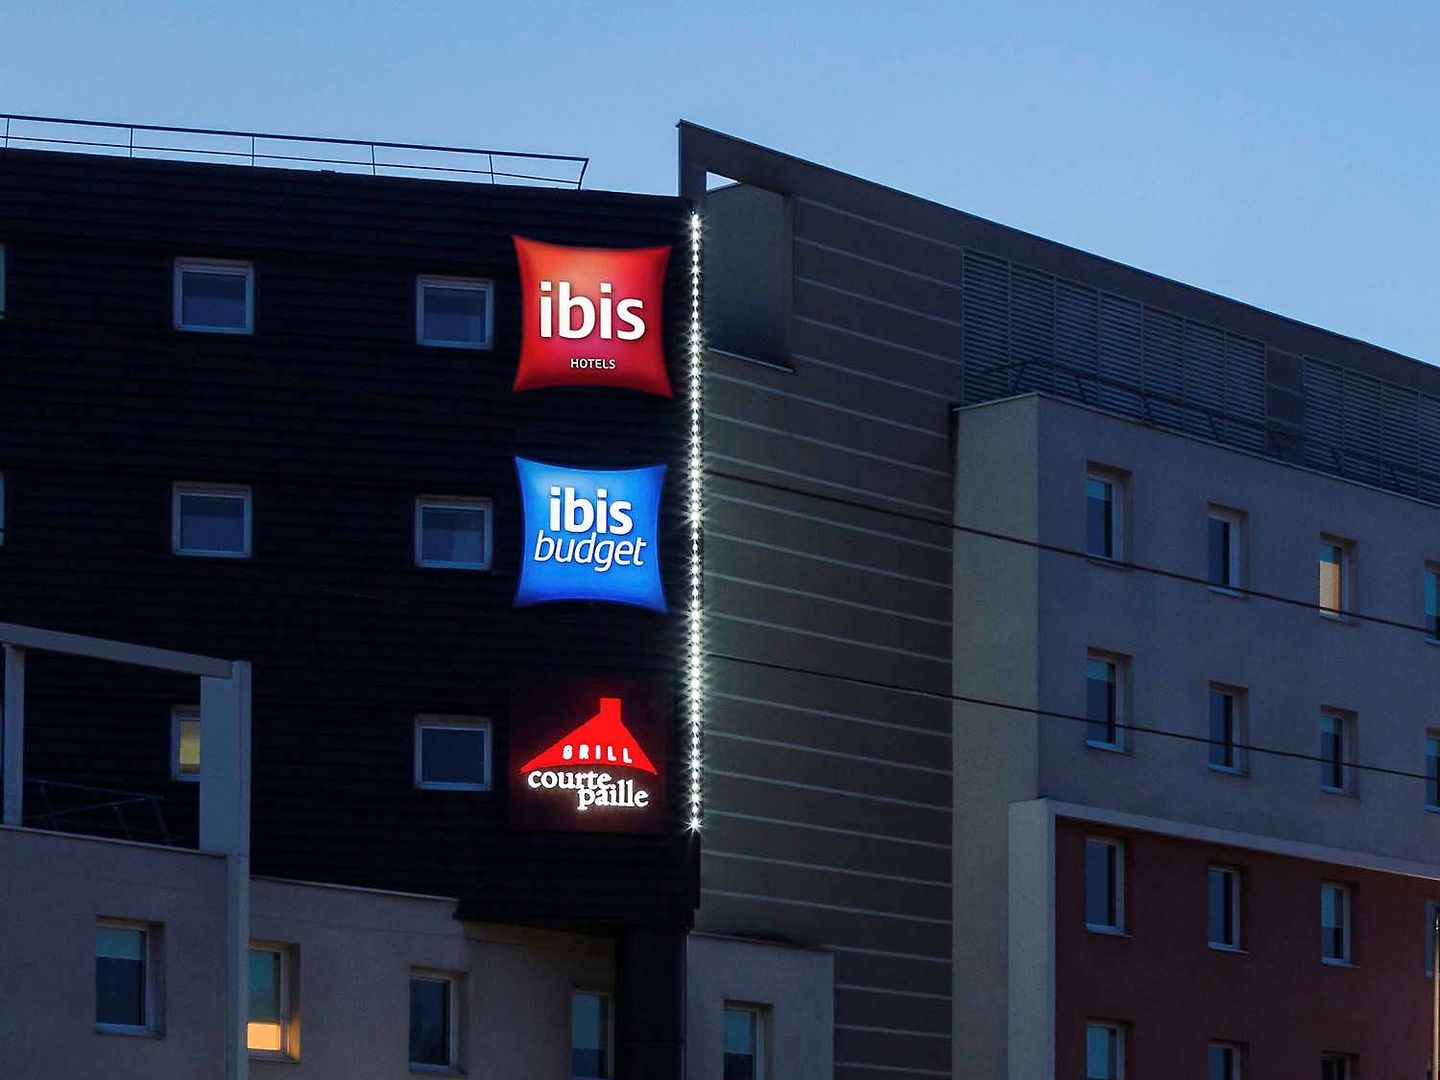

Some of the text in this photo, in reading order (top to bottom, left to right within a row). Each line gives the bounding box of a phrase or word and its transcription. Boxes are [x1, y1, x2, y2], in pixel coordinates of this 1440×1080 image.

[540, 281, 646, 341] ibis
[570, 358, 616, 370] HOTELS
[550, 486, 634, 535] ibis
[534, 530, 647, 572] budget
[562, 744, 633, 764] GRILL
[527, 771, 612, 790] courte
[576, 779, 649, 811] paille
